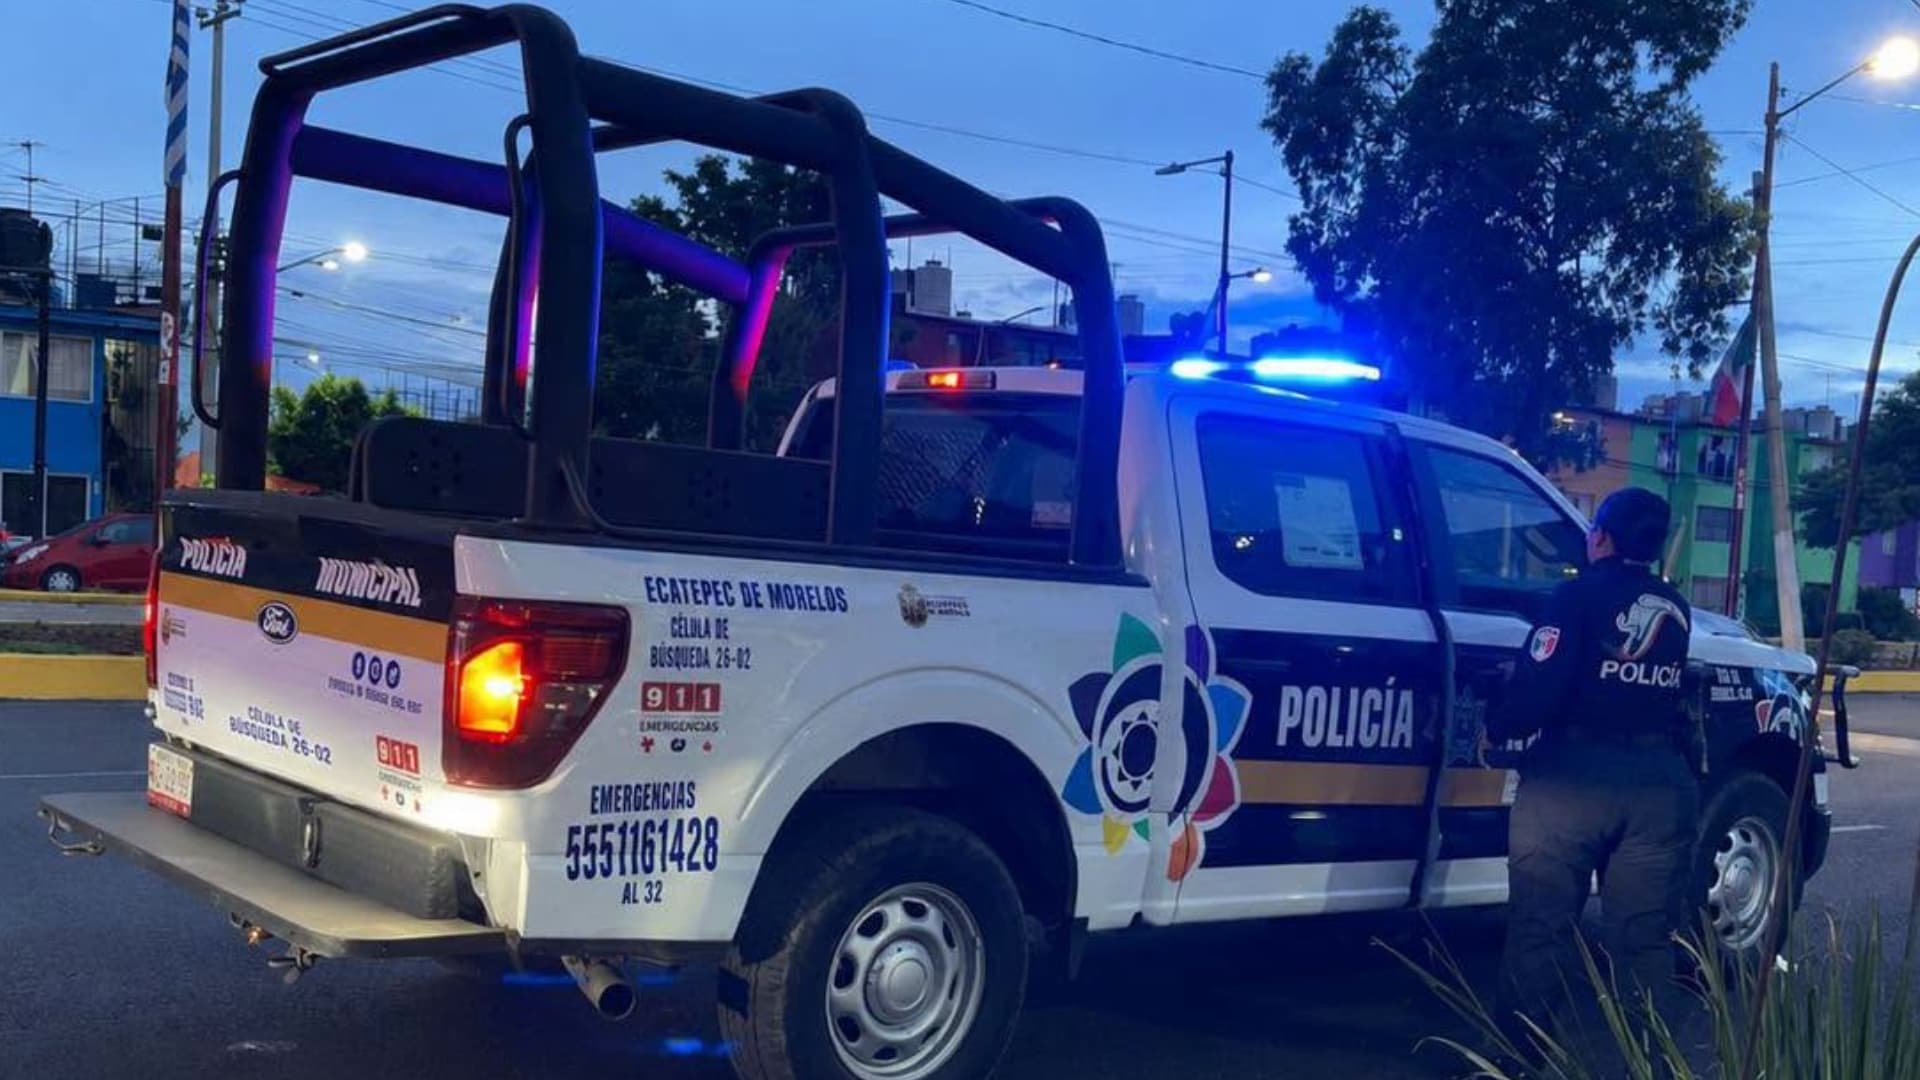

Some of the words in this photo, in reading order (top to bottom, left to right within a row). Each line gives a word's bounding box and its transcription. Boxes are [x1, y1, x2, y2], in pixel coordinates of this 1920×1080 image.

[180, 537, 247, 579] POLICÍA
[316, 557, 422, 606] MUNICIPAL
[645, 576, 733, 607] ECATEPEC
[741, 582, 763, 608] DE
[768, 583, 848, 613] MORELOS
[263, 606, 291, 637] Ford
[671, 613, 711, 639] CÉLULA
[716, 618, 728, 640] DE
[650, 641, 711, 672] BÚSQUEDA
[716, 648, 751, 669] 26-02
[1600, 660, 1681, 688] POLICÍA
[646, 688, 712, 709] 911
[1277, 676, 1414, 748] POLICÍA
[288, 717, 301, 735] DE
[640, 721, 719, 733] EMERGENCIAS
[379, 740, 416, 771] 911
[591, 781, 696, 815] EMERGENCIAS
[566, 816, 719, 880] 5551161428
[622, 882, 638, 904] AL
[645, 880, 663, 903] 32
